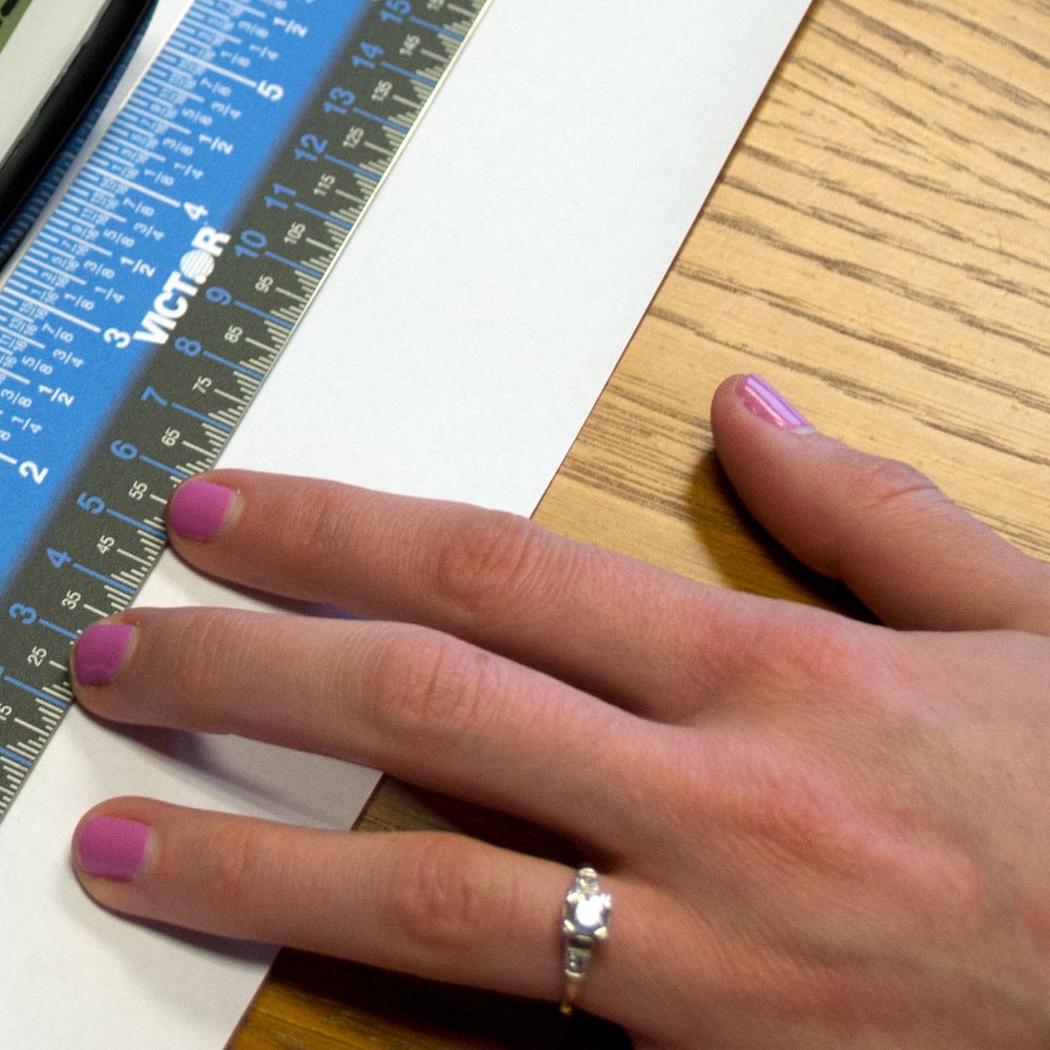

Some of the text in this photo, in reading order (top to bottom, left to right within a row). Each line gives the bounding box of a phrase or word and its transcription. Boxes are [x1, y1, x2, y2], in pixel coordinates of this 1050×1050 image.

[351, 41, 384, 69] 14
[256, 80, 285, 102] 5
[323, 87, 356, 115] 13
[294, 133, 328, 162] 12
[313, 173, 336, 196] 115
[264, 183, 297, 210] 11
[183, 201, 209, 221] 4
[234, 229, 268, 259] 10
[283, 221, 307, 245] 105
[132, 225, 231, 346] VICTOR
[254, 274, 274, 294] 95
[205, 286, 233, 306] 9
[103, 327, 132, 349] 3
[224, 324, 244, 344] 85
[173, 336, 202, 357] 8
[192, 375, 213, 394] 75
[140, 385, 168, 407] 7
[161, 427, 181, 447] 65
[110, 439, 138, 461] 6
[18, 460, 49, 485] 2
[128, 480, 148, 501] 55
[76, 492, 105, 515] 5
[96, 534, 116, 555] 45
[45, 547, 72, 569] 4
[61, 589, 82, 611] 35
[8, 602, 37, 625] 3
[26, 645, 48, 667] 25
